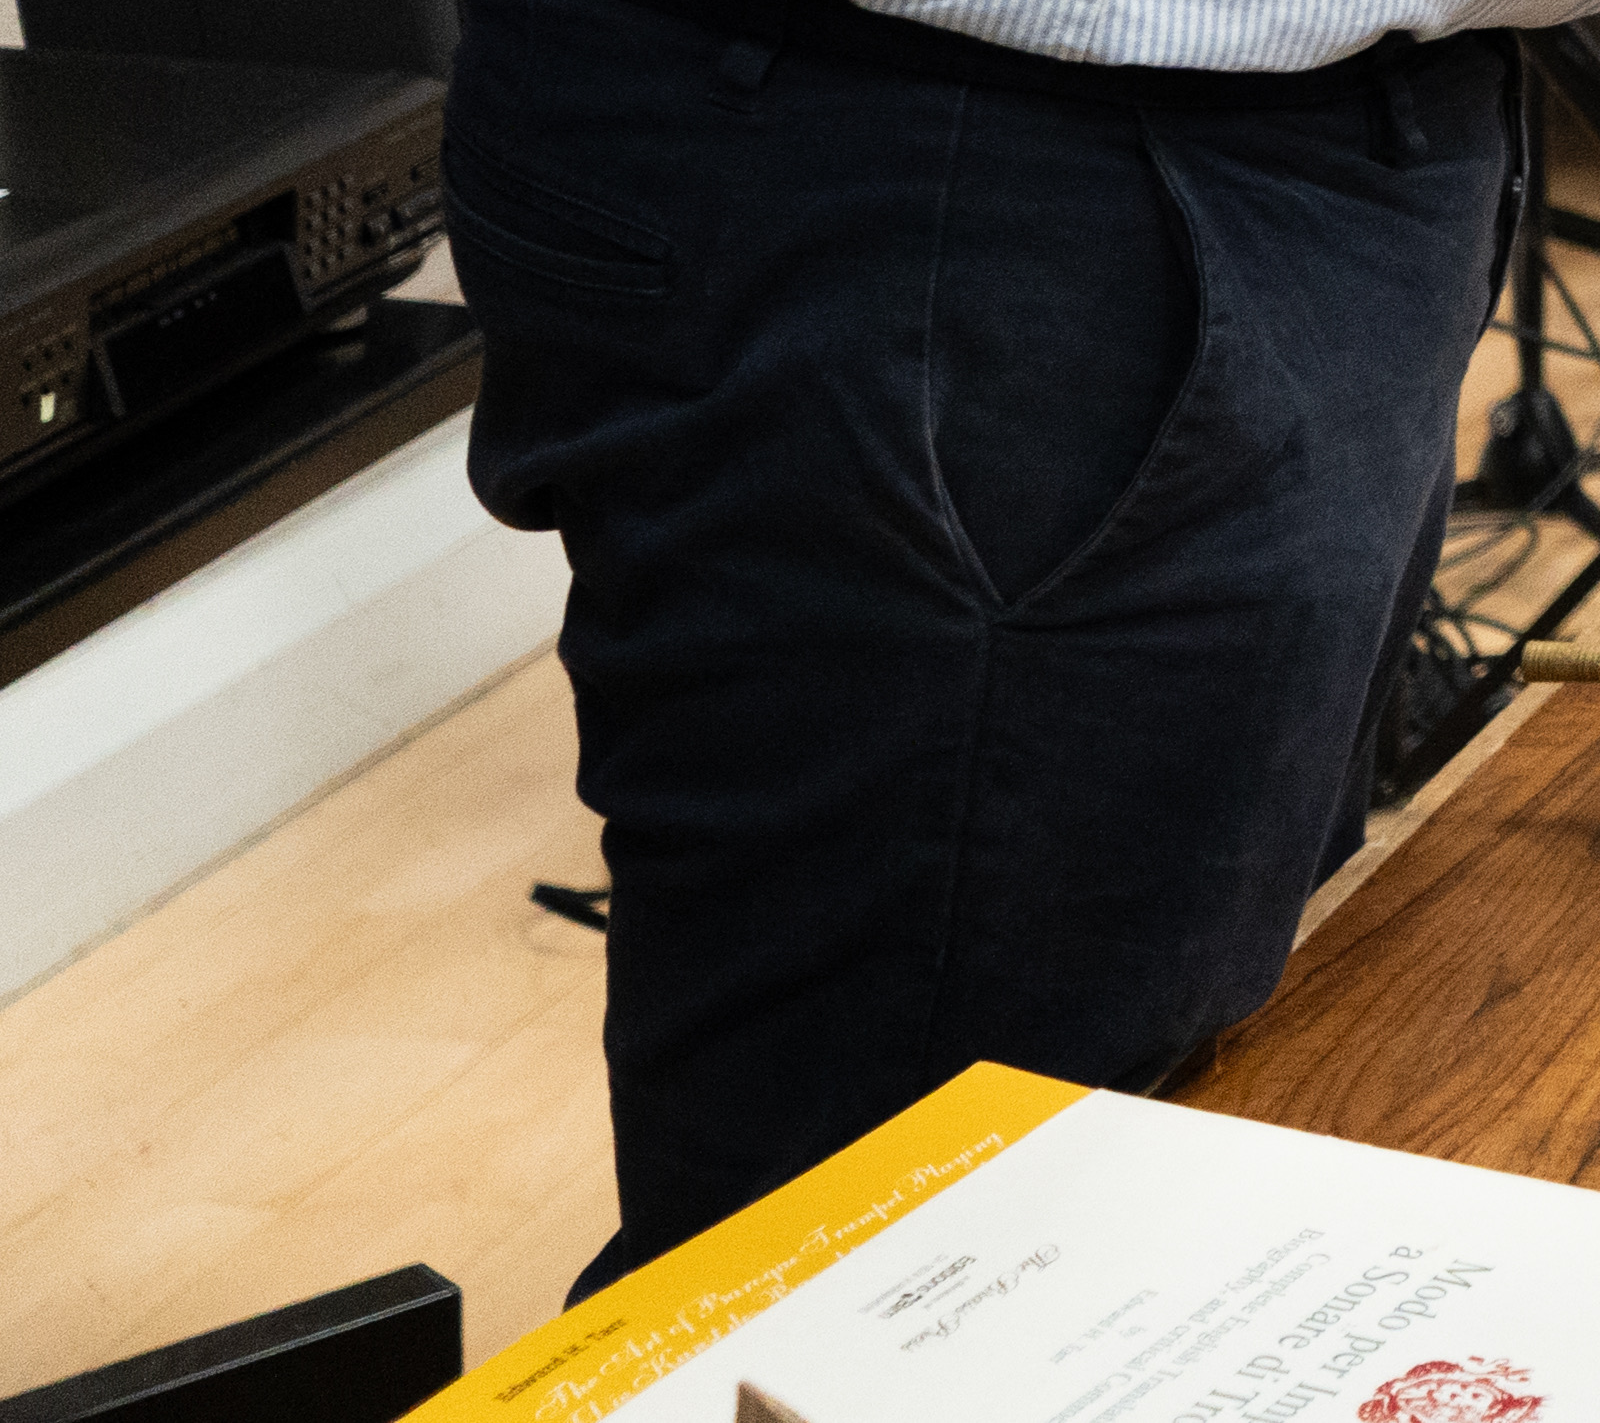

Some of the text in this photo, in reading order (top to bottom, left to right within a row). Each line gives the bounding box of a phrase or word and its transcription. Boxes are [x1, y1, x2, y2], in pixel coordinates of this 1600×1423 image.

[1016, 1244, 1060, 1272] The
[1220, 1228, 1324, 1295] Biography,
[1389, 1246, 1423, 1260] a
[535, 1375, 599, 1421] The
[599, 1329, 664, 1378] Art
[664, 1306, 698, 1345] of
[690, 1256, 799, 1319] Baroque
[799, 1189, 905, 1253] Trumpet
[907, 1132, 1004, 1192] Playing
[953, 1272, 1019, 1316] Brass
[1241, 1253, 1330, 1314] Complete
[1377, 1259, 1494, 1331] Modo
[1188, 1298, 1227, 1324] and
[1278, 1266, 1408, 1349] Sonare
[900, 1314, 960, 1352] Press
[1124, 1325, 1190, 1371] critical
[1173, 1316, 1250, 1365] English
[1320, 1332, 1386, 1379] per
[1236, 1355, 1290, 1383] di
